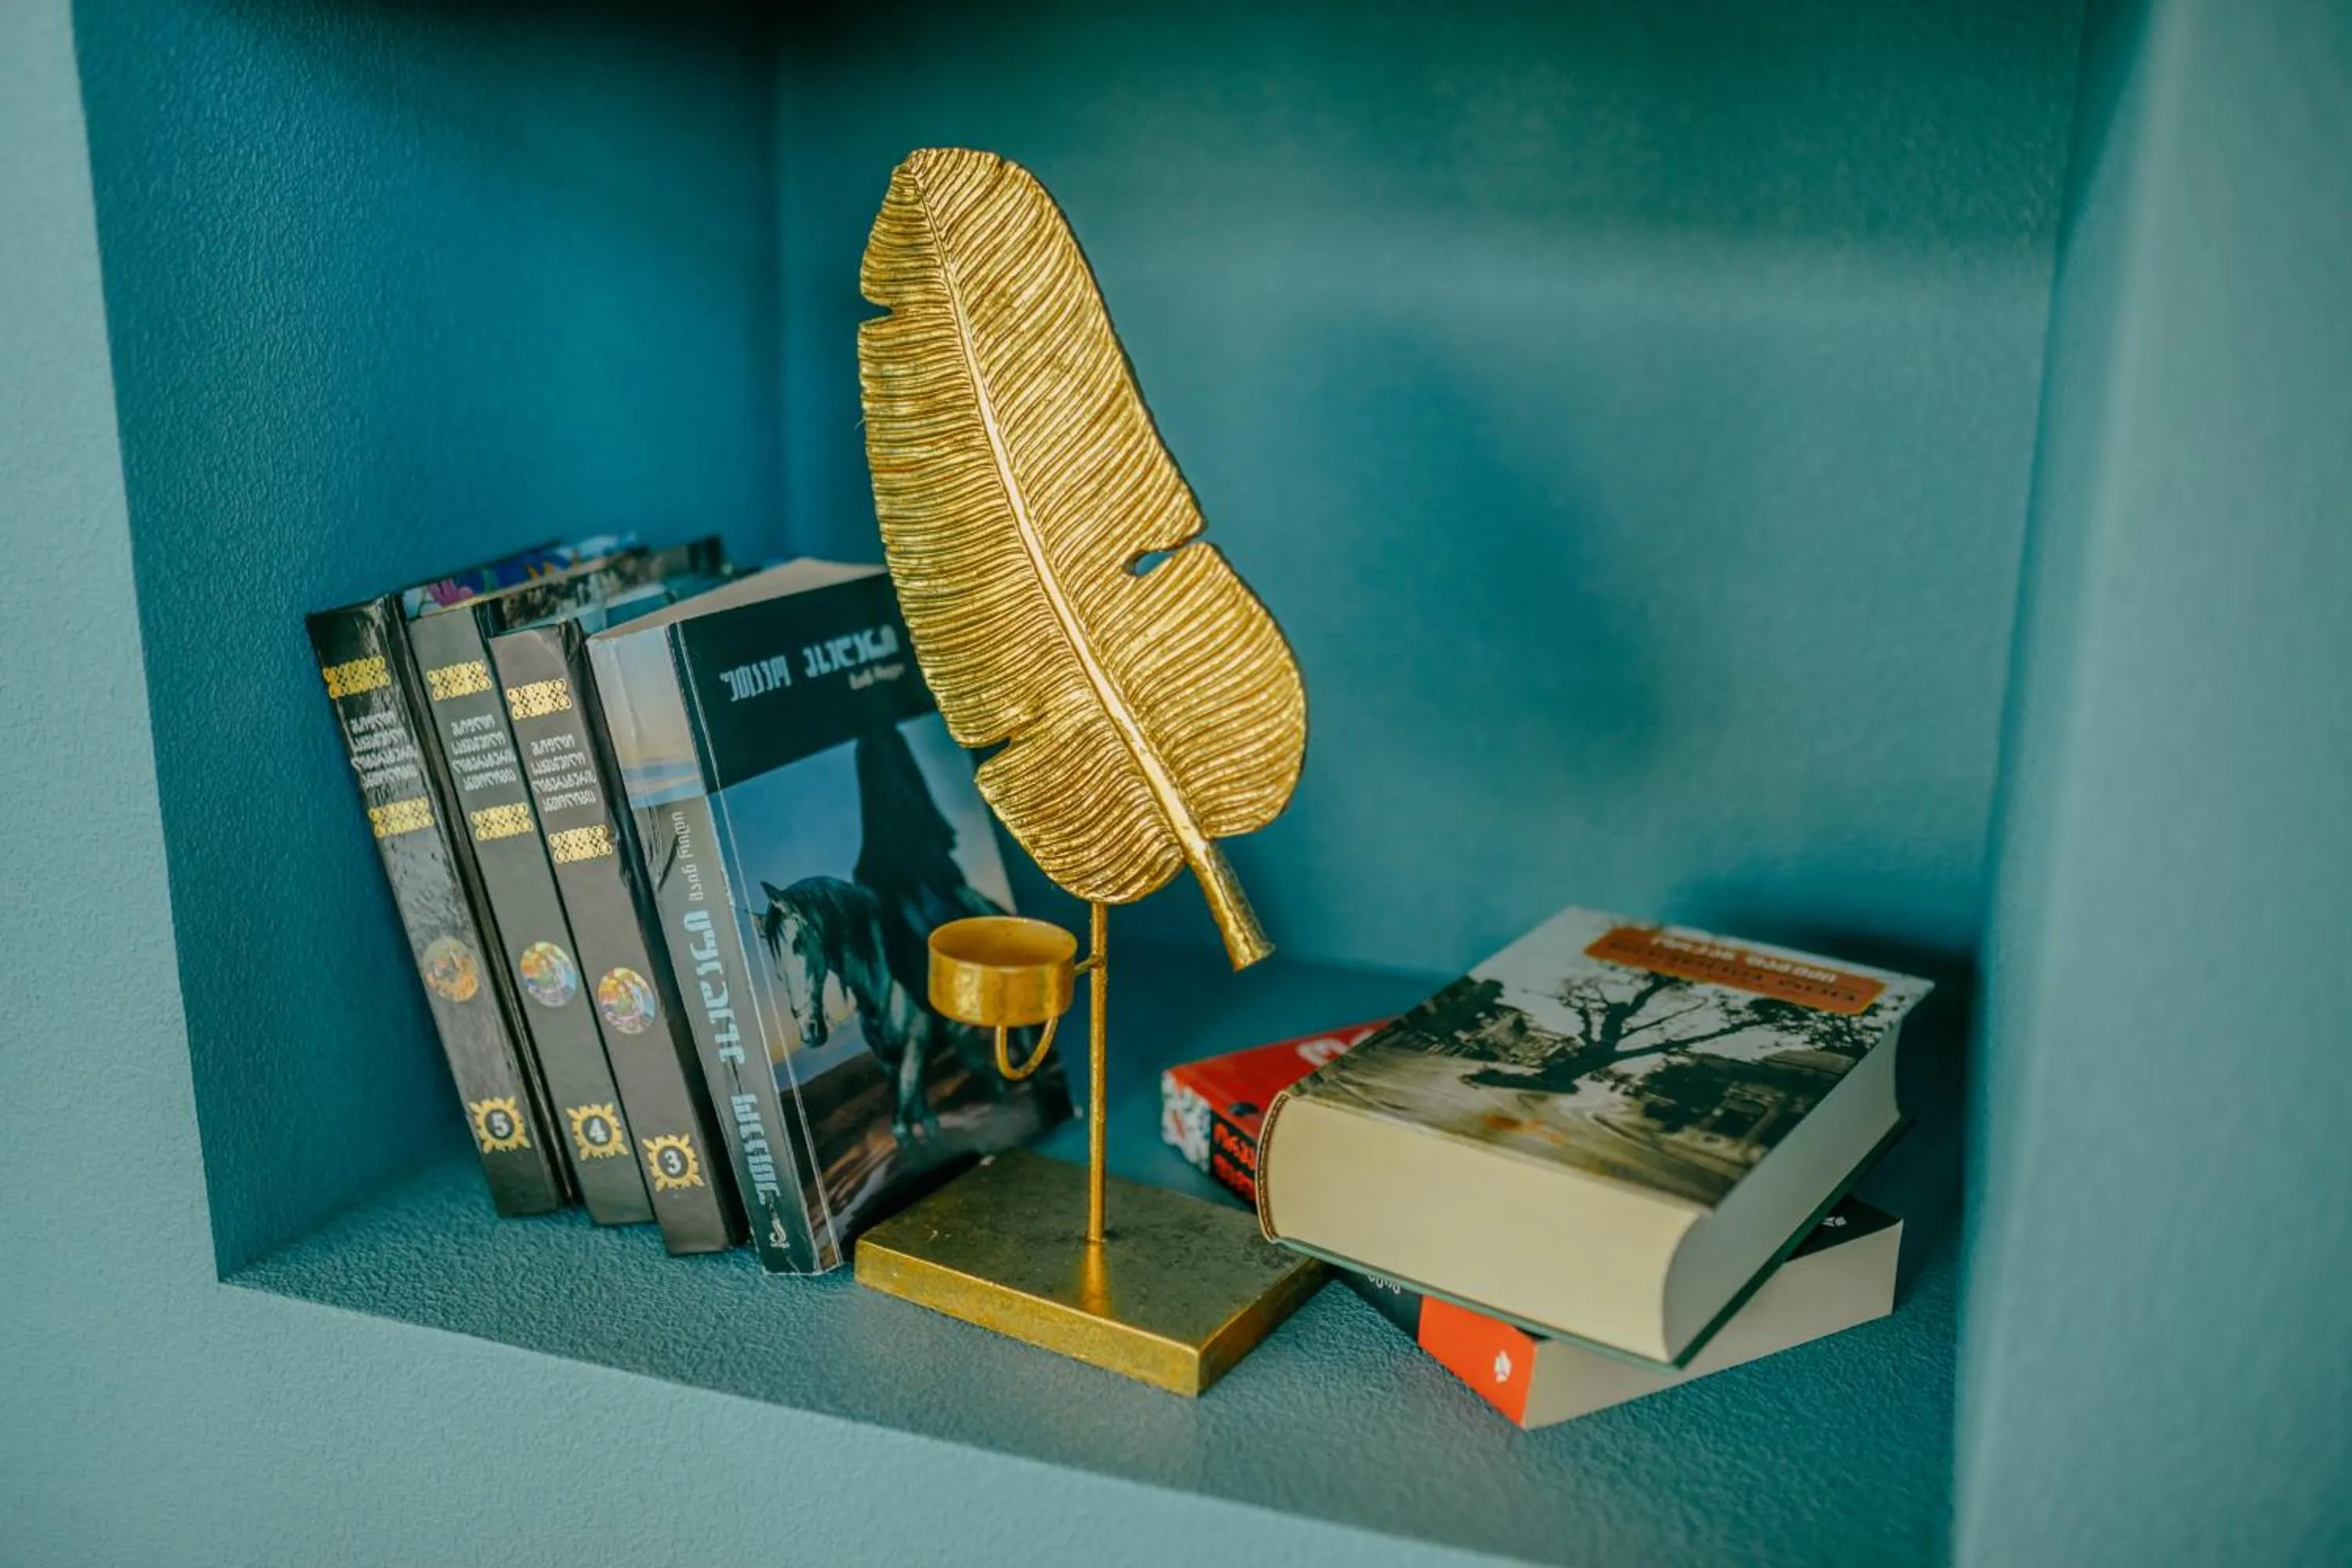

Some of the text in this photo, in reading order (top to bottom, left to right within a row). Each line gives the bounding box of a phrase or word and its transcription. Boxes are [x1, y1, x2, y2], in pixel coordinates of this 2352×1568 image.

[672, 811, 704, 902] მაინ რიდი
[492, 1116, 510, 1136] 5
[589, 1120, 606, 1143] 4
[663, 1150, 682, 1173] 3
